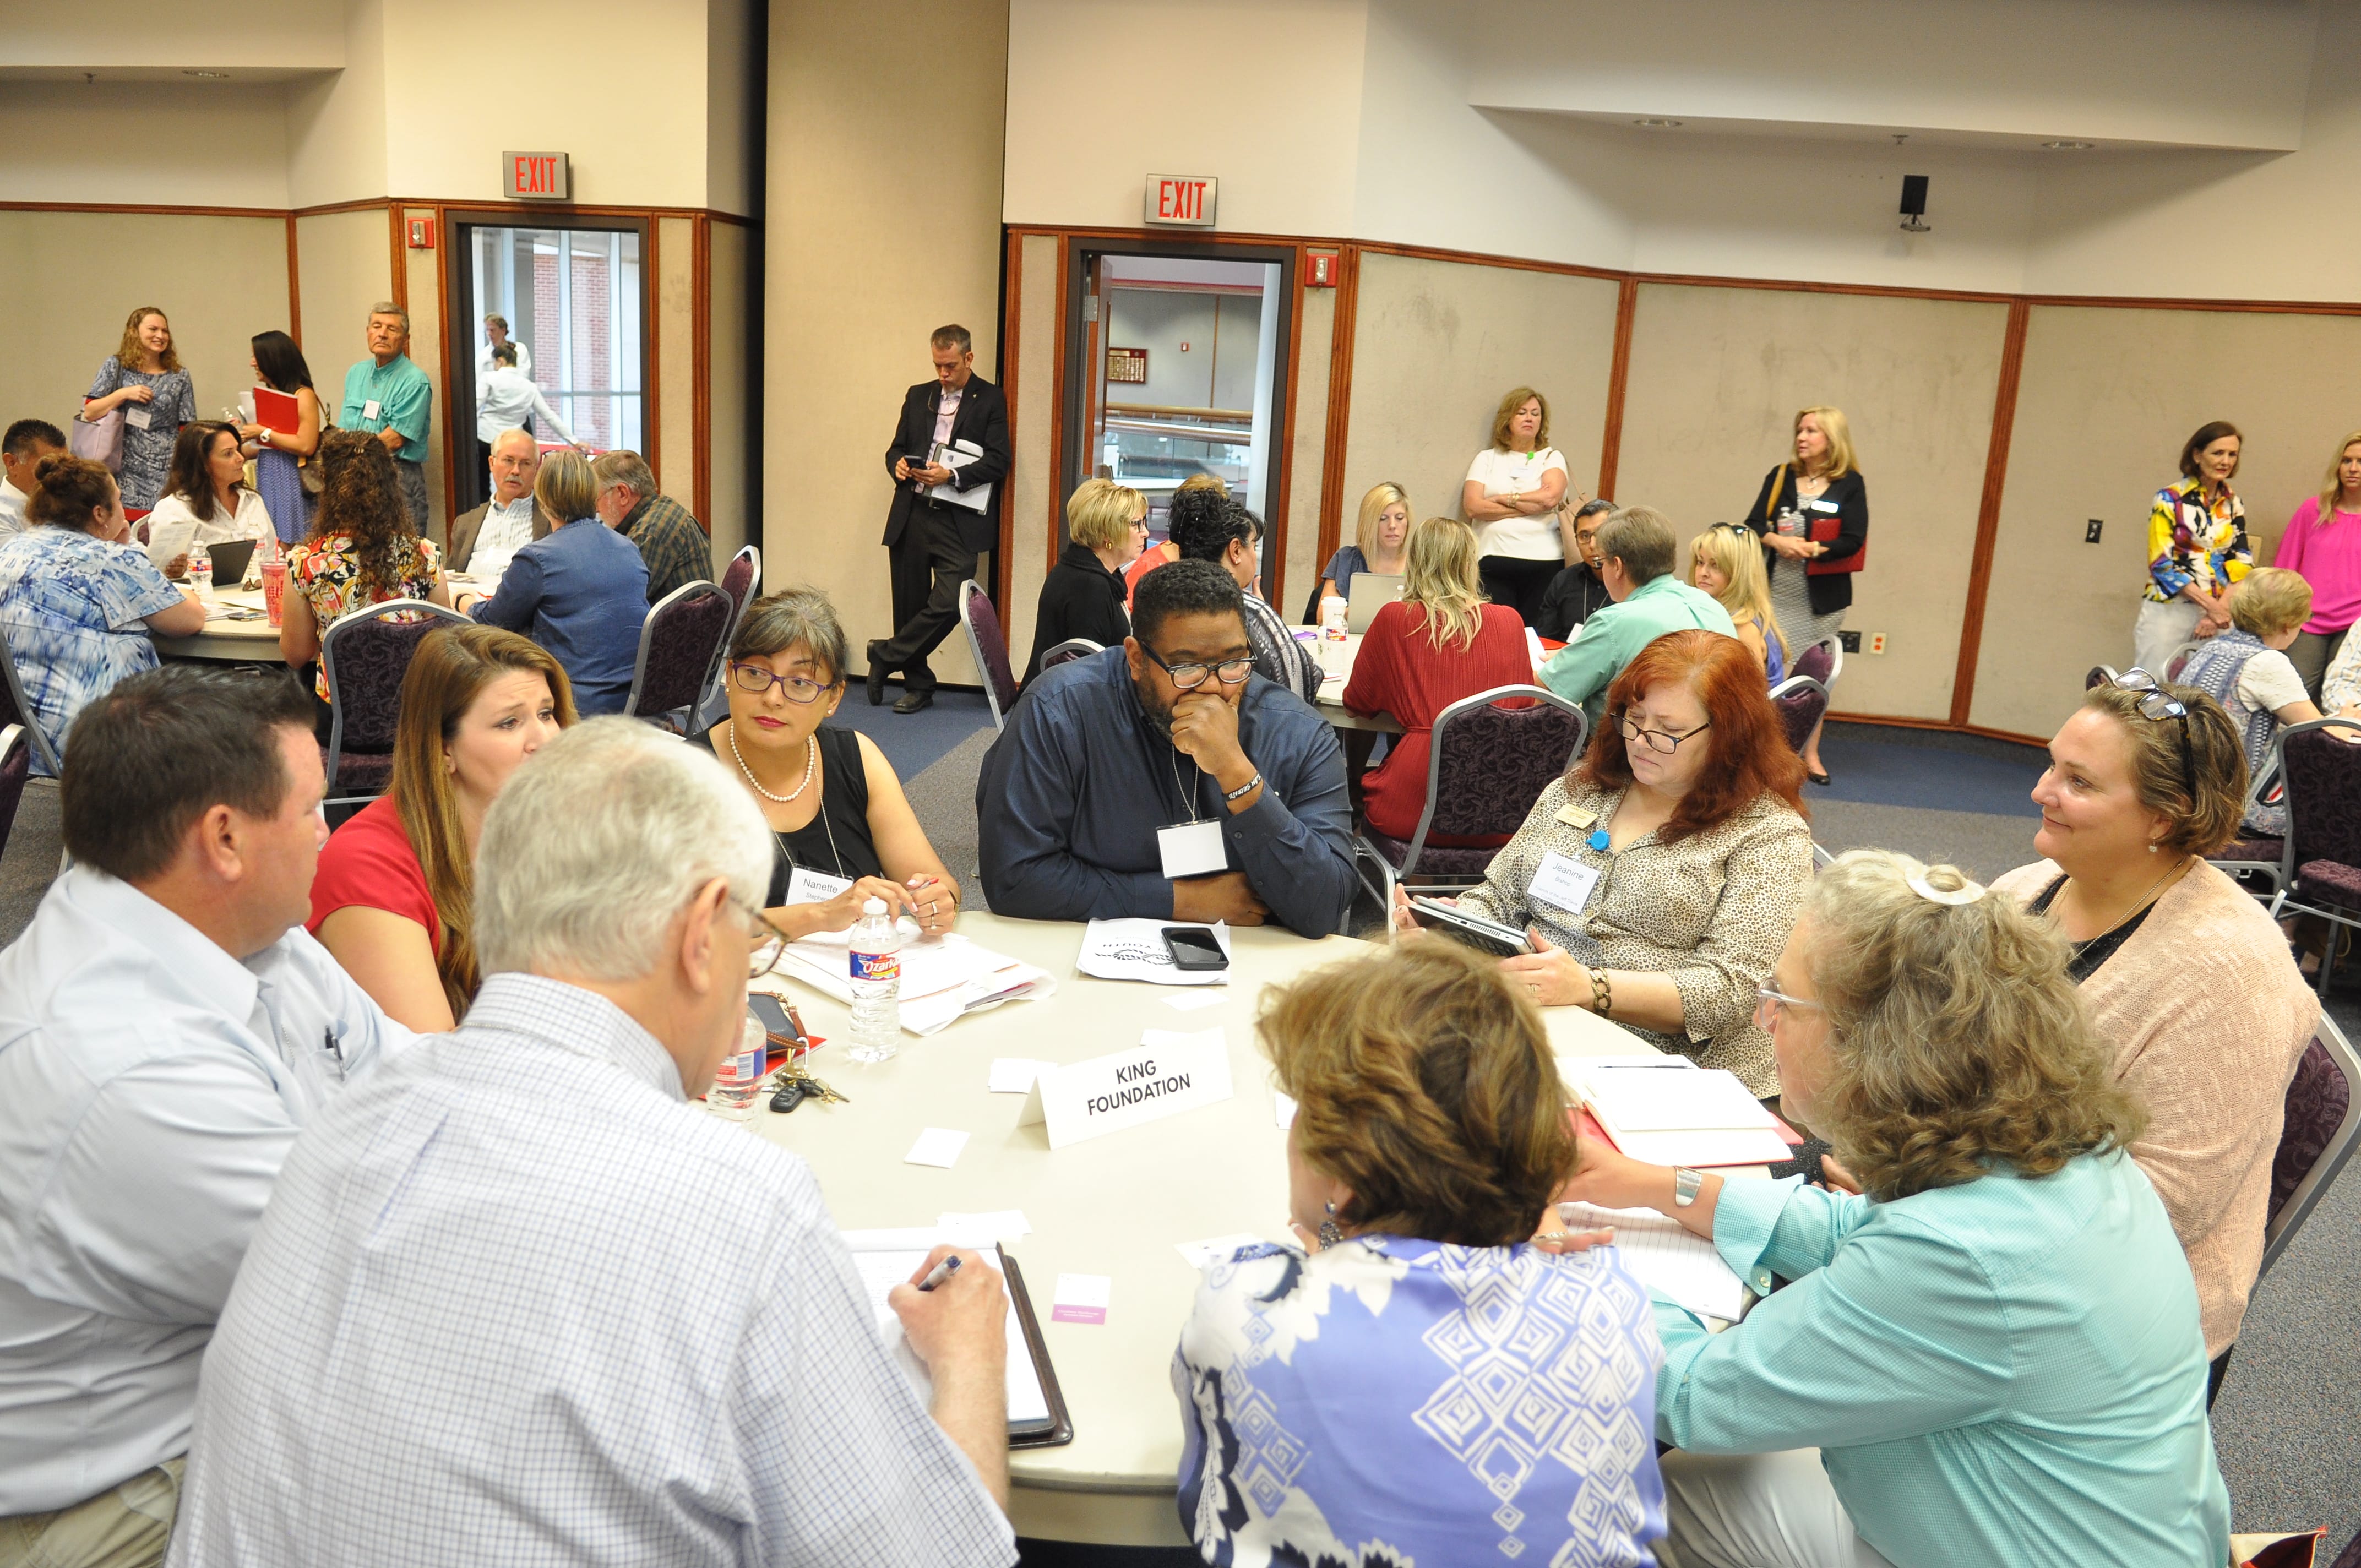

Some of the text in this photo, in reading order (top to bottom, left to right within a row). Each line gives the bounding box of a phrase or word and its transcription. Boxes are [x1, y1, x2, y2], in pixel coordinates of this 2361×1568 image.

[515, 157, 556, 192] EXIT
[1158, 181, 1206, 219] EXIT
[1552, 863, 1584, 880] Jeanine
[1554, 876, 1571, 887] Bishop
[803, 878, 838, 894] Nanette
[1116, 1060, 1156, 1085] KING
[1087, 1073, 1190, 1116] FOUNDATION
